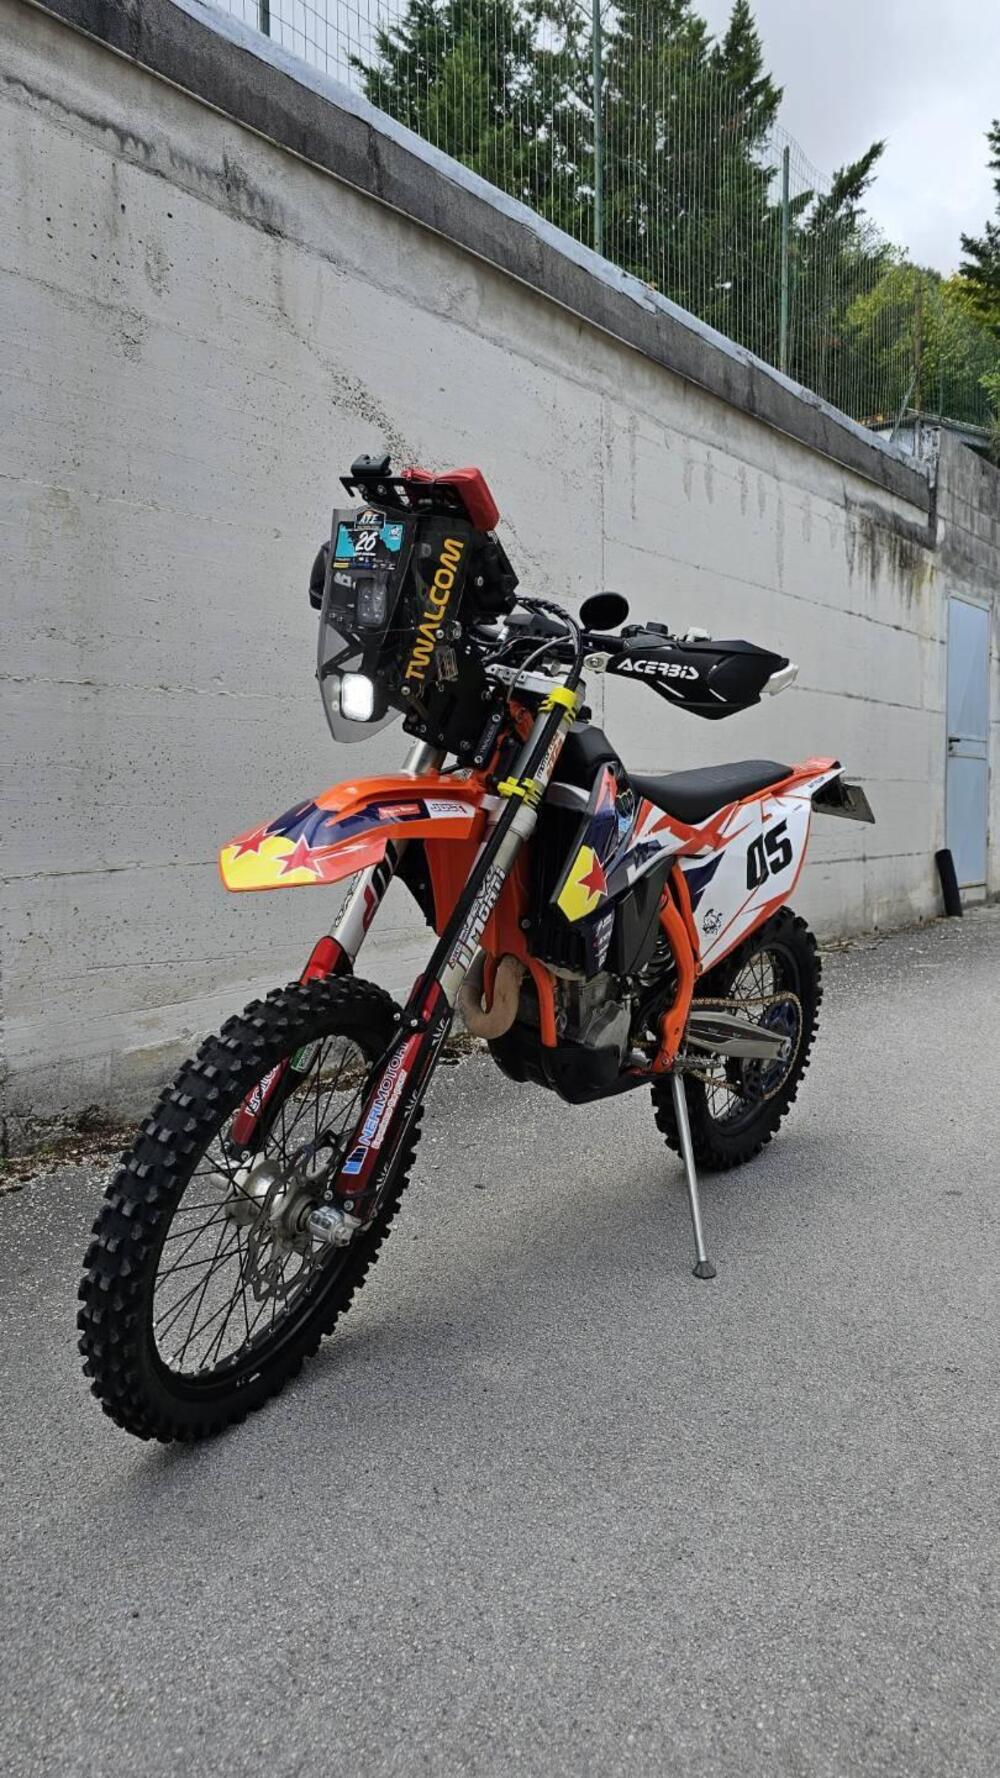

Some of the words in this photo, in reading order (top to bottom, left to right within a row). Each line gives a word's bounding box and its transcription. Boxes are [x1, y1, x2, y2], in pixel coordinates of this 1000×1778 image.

[355, 531, 378, 552] 26
[404, 537, 465, 682] TWALCOM
[616, 657, 700, 681] ACERBIS
[746, 817, 793, 891] 05
